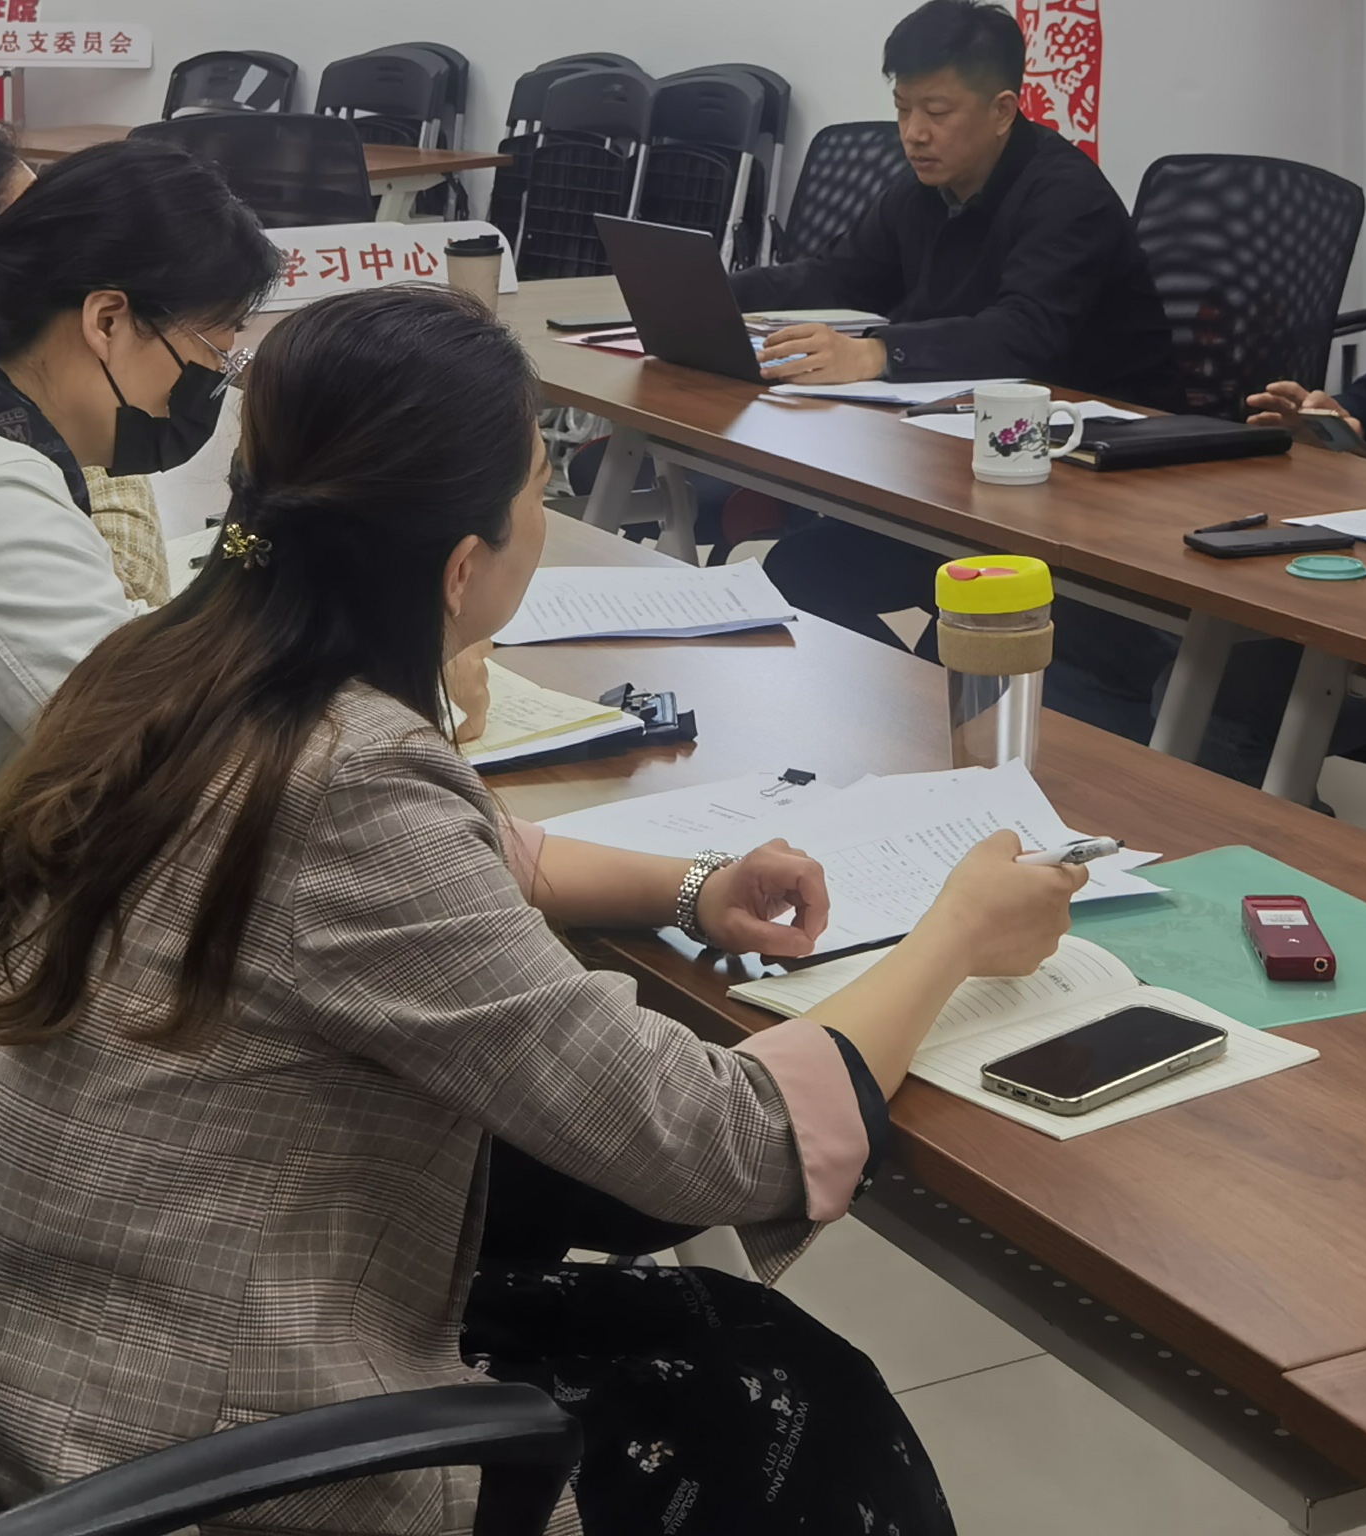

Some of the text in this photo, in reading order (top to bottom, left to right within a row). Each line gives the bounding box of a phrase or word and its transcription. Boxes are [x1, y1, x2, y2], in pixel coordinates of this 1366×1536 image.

[282, 239, 453, 288] 学习中心
[762, 1417, 789, 1477] IN CITY
[765, 1401, 810, 1503] WONDERLAND
